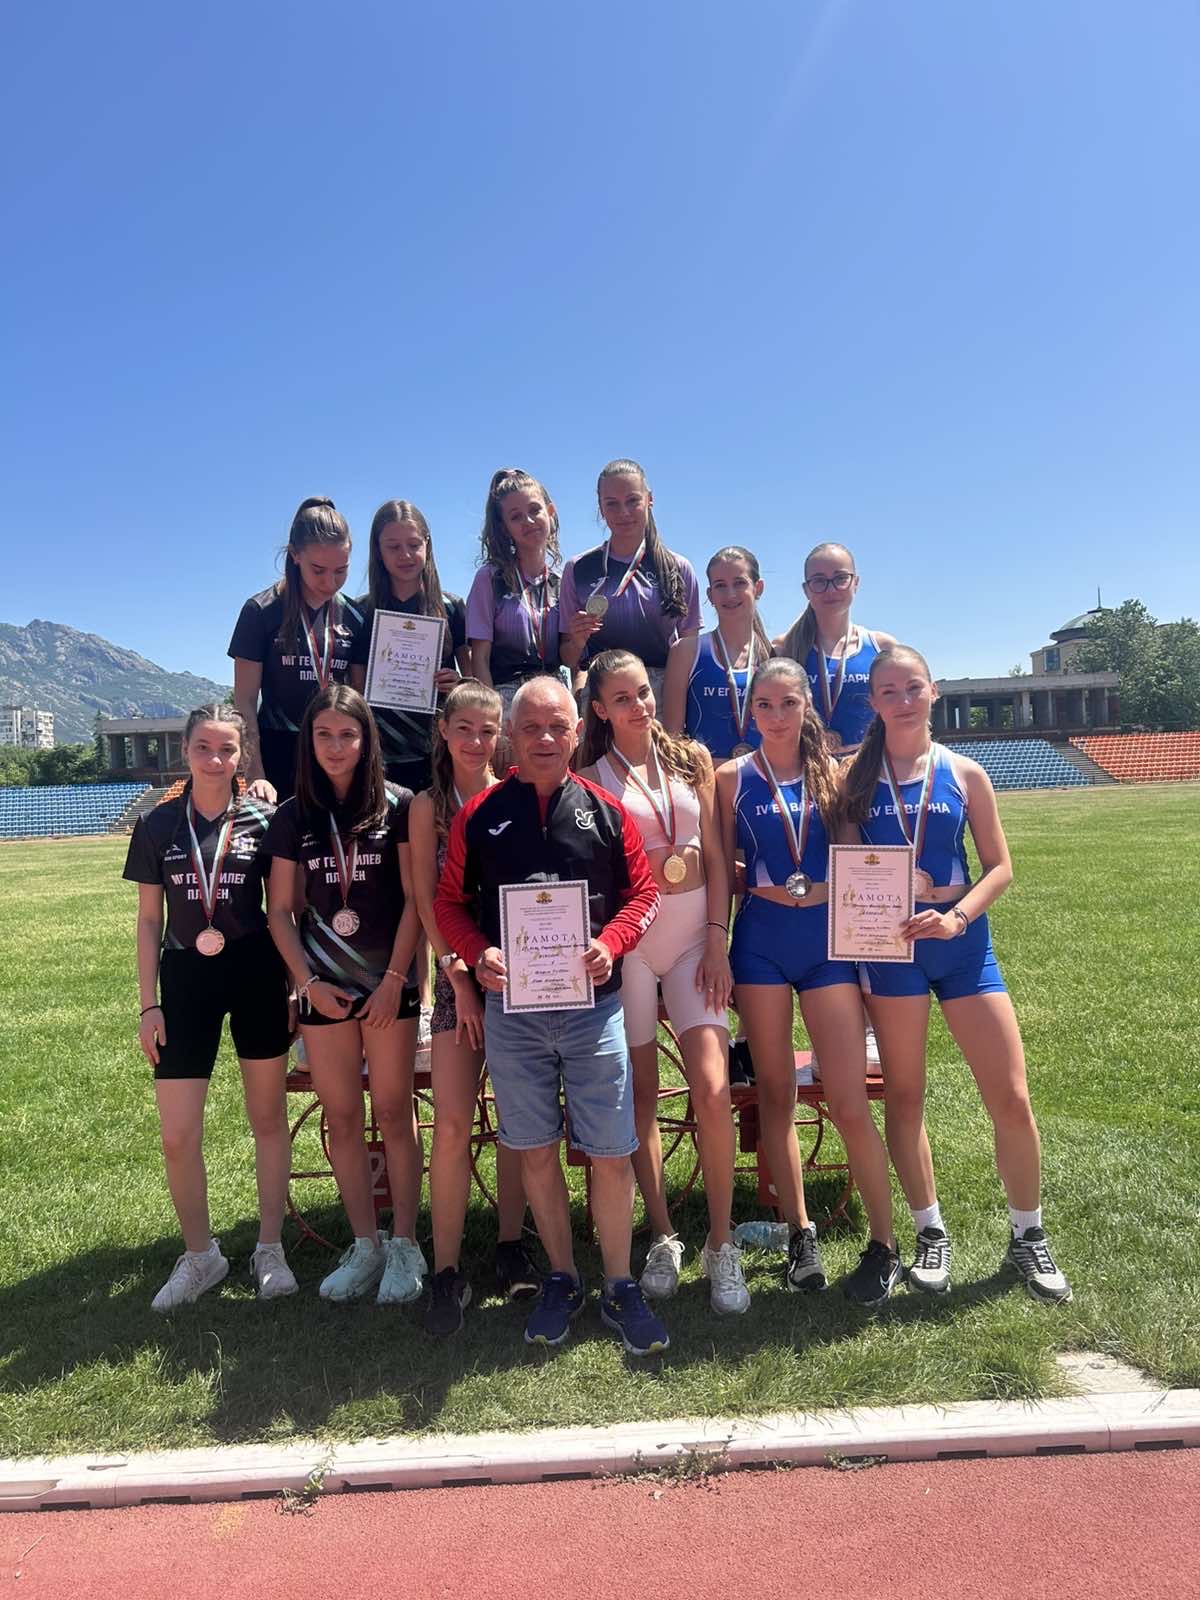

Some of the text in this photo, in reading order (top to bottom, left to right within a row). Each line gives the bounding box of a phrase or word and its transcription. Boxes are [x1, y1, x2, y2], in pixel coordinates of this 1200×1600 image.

[281, 655, 296, 666] МГ
[842, 673, 870, 683] ВАРН
[703, 687, 715, 696] IV
[755, 804, 768, 816] IV
[308, 857, 320, 871] МГ
[324, 856, 337, 868] ГЕ
[186, 872, 199, 885] ГЕ
[325, 870, 366, 884] ПЛЕН
[187, 888, 229, 900] ПЛЕН
